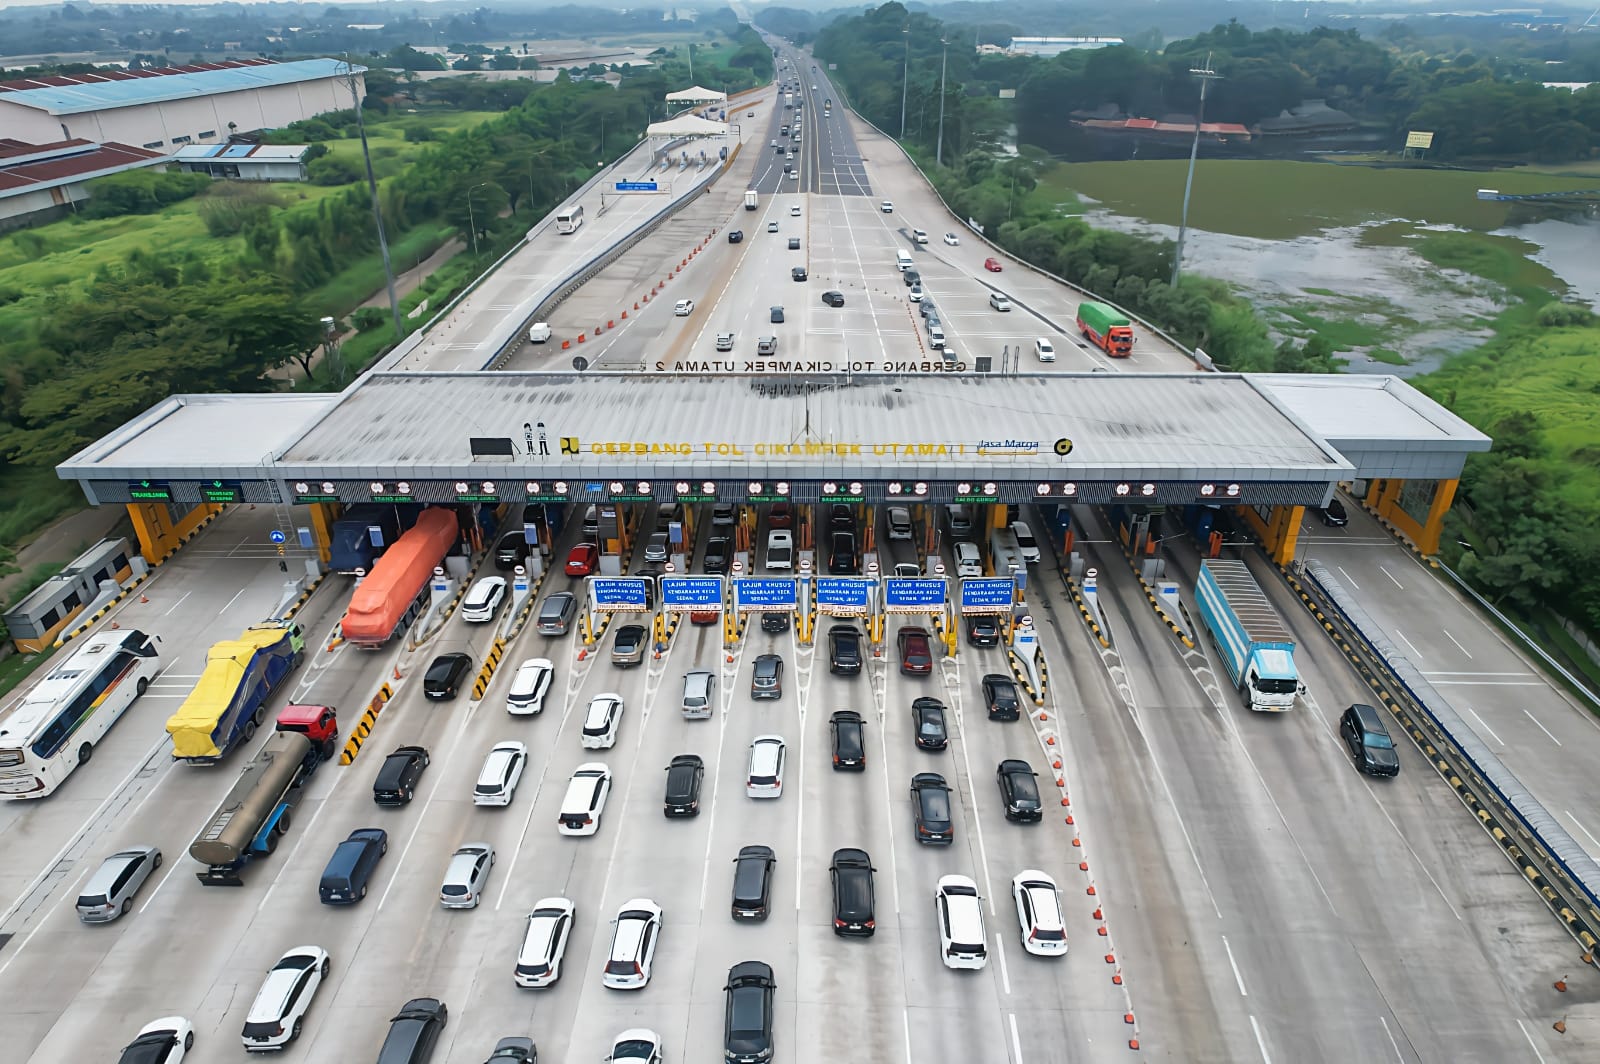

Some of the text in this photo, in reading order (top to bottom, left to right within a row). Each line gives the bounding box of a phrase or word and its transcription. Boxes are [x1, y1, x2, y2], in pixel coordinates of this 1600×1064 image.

[592, 442, 692, 456] GERBANG
[704, 442, 744, 456] TOL
[754, 442, 862, 456] CIKAMPEK
[873, 442, 948, 456] UTAMA
[978, 439, 1039, 450] Jasa Marga
